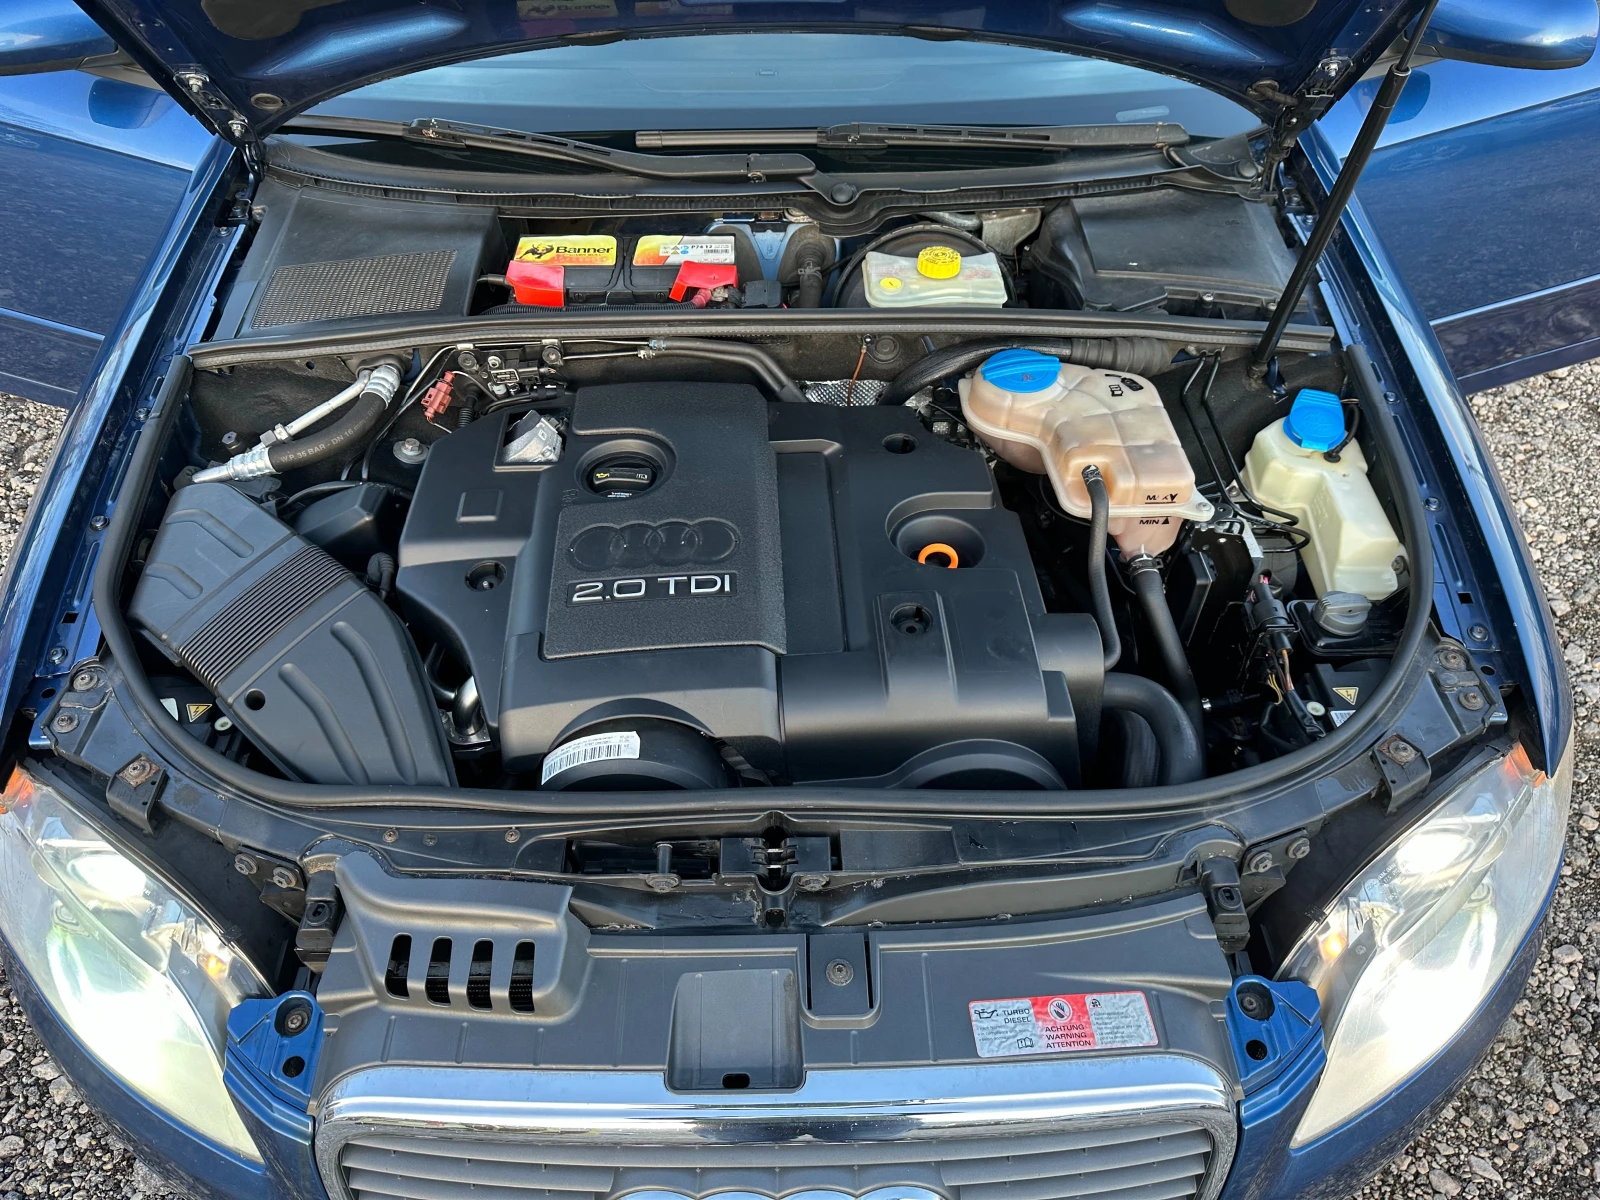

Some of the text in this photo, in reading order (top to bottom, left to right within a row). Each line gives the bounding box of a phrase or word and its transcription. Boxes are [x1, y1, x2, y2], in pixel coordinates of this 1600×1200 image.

[555, 246, 613, 254] Banner
[297, 450, 307, 459] 35
[307, 443, 326, 456] BAR
[331, 435, 344, 445] DN
[344, 428, 354, 437] 16
[572, 574, 731, 603] 2.0 TDI
[1002, 1008, 1030, 1016] TURBO
[1003, 1016, 1032, 1024] DIESEL
[1045, 1024, 1085, 1033] ACHTUNG
[1046, 1032, 1087, 1041] WARNING
[1046, 1040, 1091, 1049] ATTENTION
